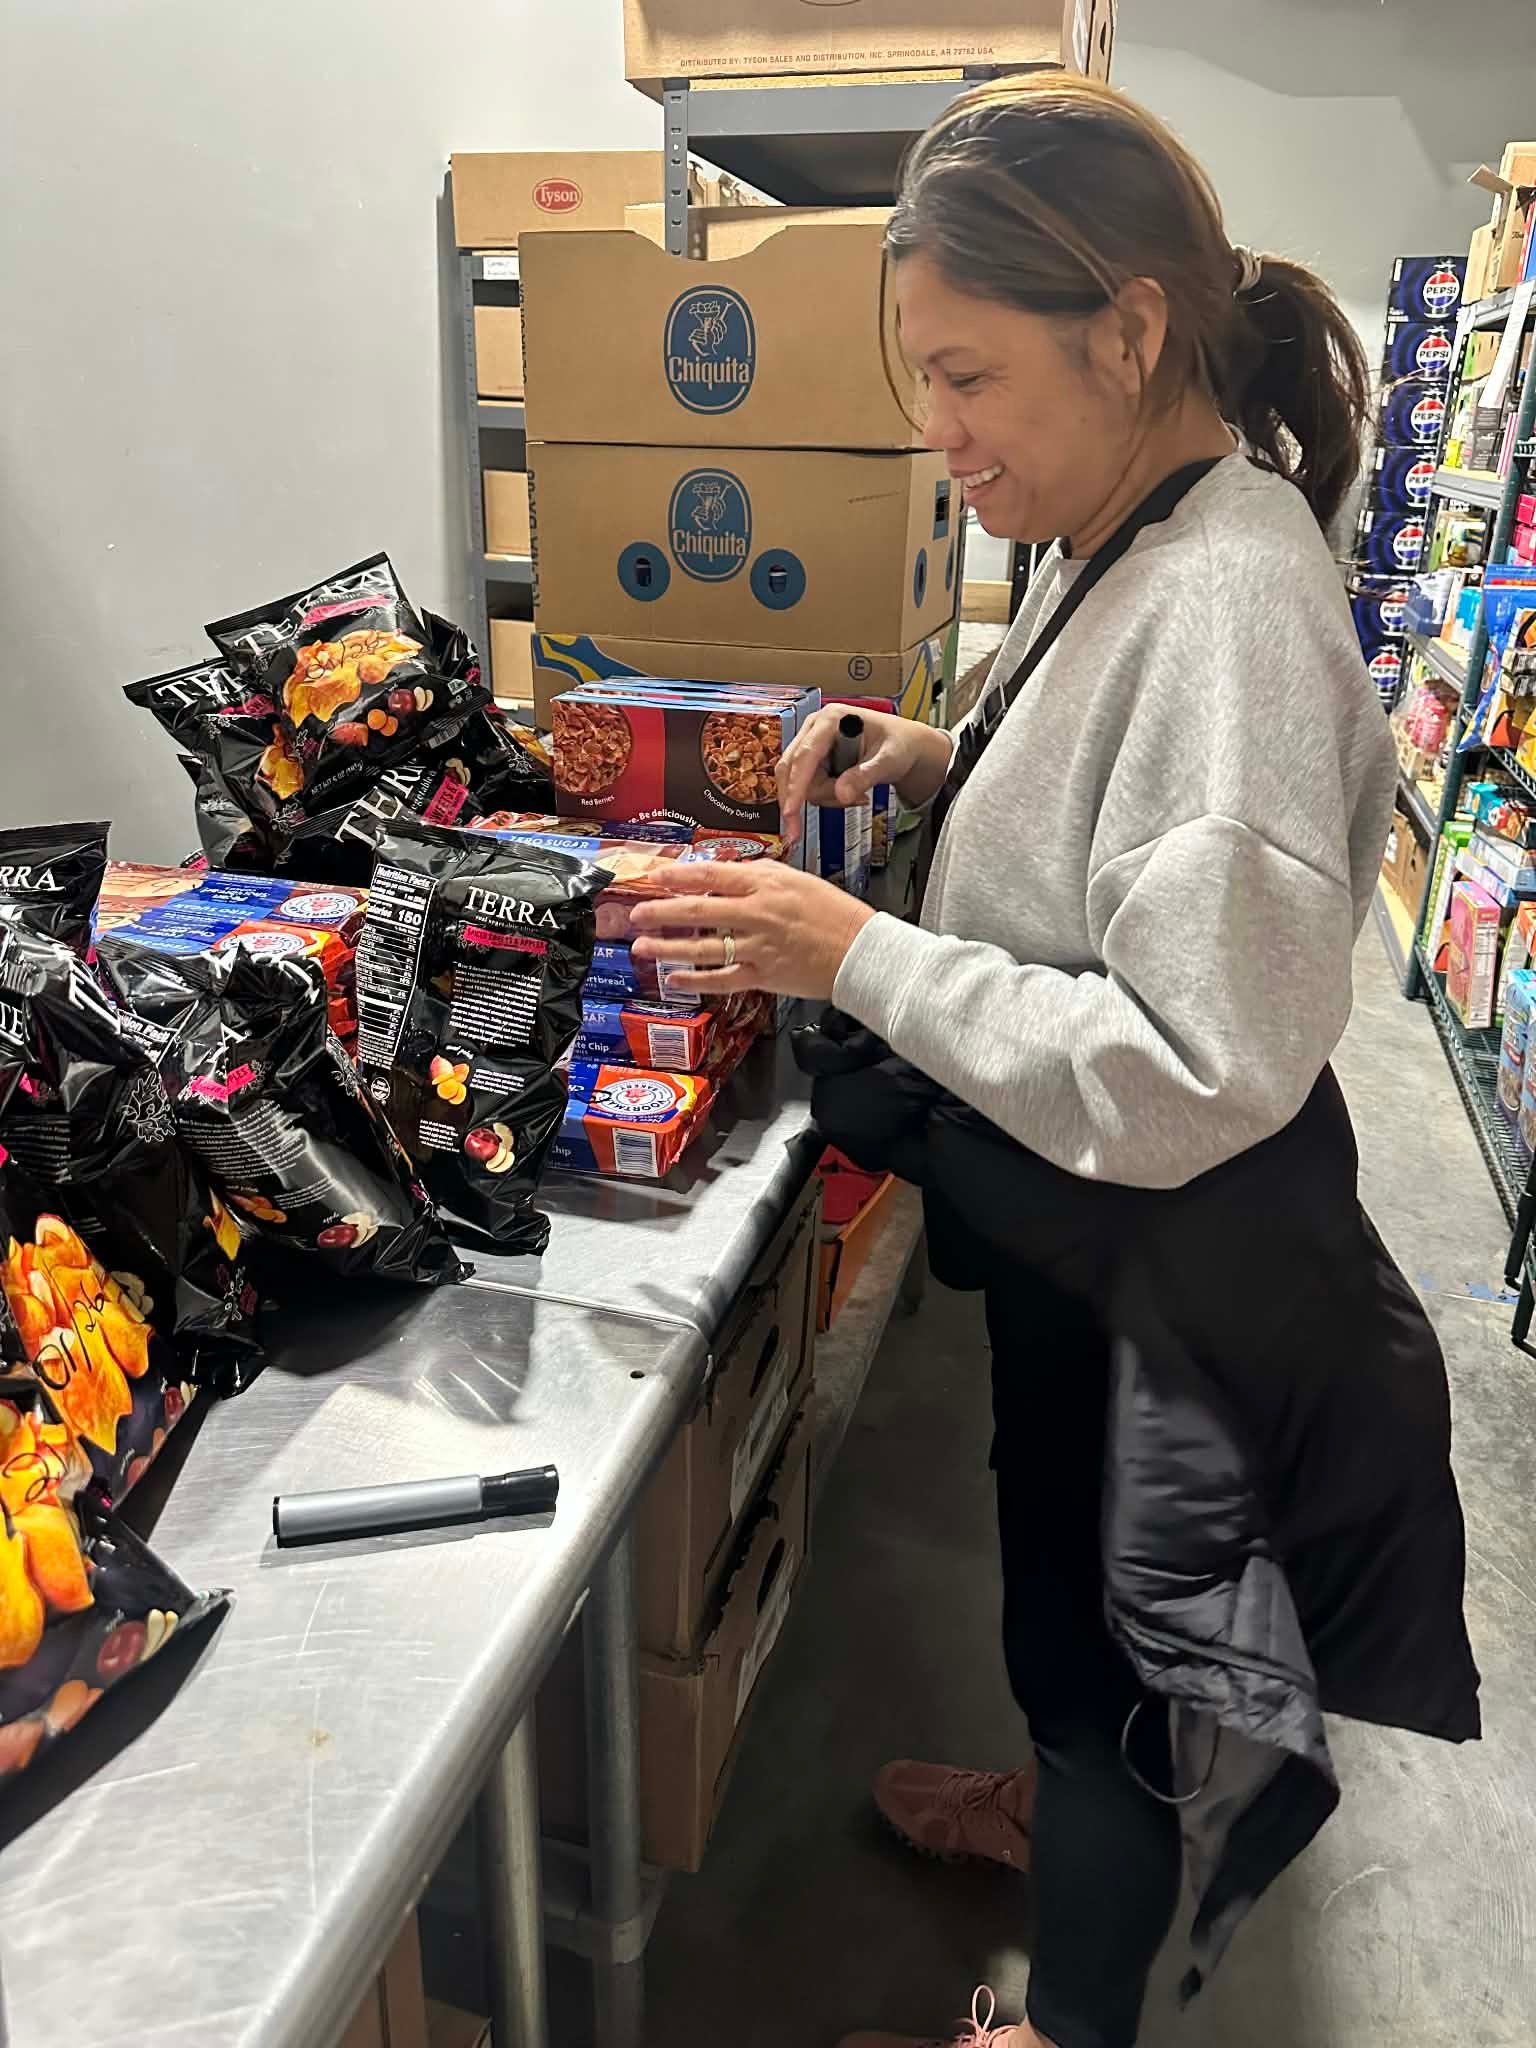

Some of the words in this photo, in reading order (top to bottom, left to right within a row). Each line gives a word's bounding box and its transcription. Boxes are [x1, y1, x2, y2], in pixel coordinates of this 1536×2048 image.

[795, 54, 811, 62] AND
[537, 186, 578, 207] Tyson
[1426, 286, 1457, 294] PEPSI
[1419, 350, 1449, 358] PEPSI
[668, 356, 749, 391] Chiquita
[672, 529, 746, 562] Chiquita
[855, 660, 865, 676] E
[581, 798, 594, 806] Red
[594, 794, 615, 805] Berries
[703, 789, 735, 816] Chocolatey
[735, 809, 760, 820] Delight
[639, 812, 650, 821] Be
[651, 808, 697, 827] deliciously
[548, 839, 589, 850] SUGAR
[464, 886, 560, 929] TERRA
[399, 909, 422, 926] 150
[588, 1042, 609, 1053] Chip
